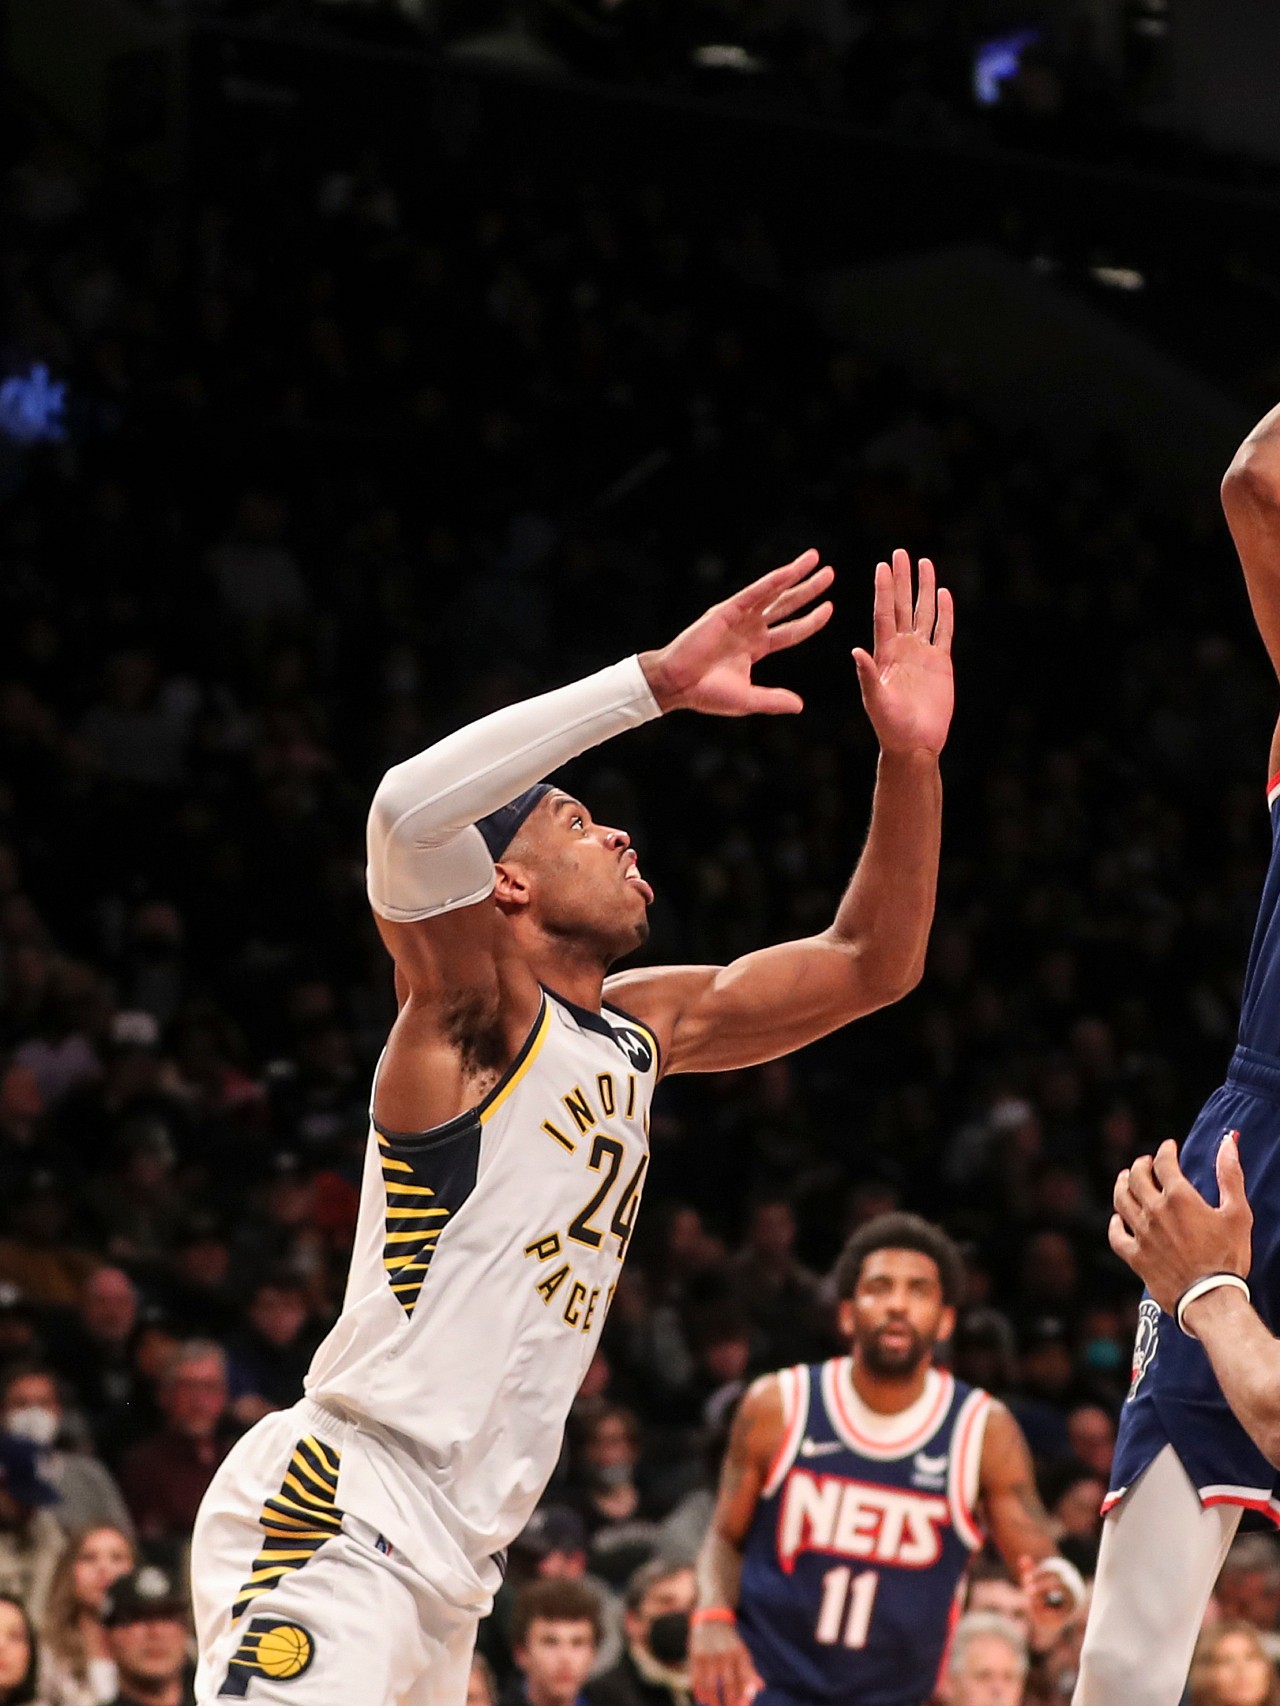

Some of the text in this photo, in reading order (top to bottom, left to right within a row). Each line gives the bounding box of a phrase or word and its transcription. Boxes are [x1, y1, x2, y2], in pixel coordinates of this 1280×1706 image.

[541, 1072, 649, 1154] INDI
[568, 1134, 649, 1262] 24
[524, 1232, 616, 1334] PACE
[777, 1469, 950, 1573] NETS
[815, 1566, 878, 1649] 11
